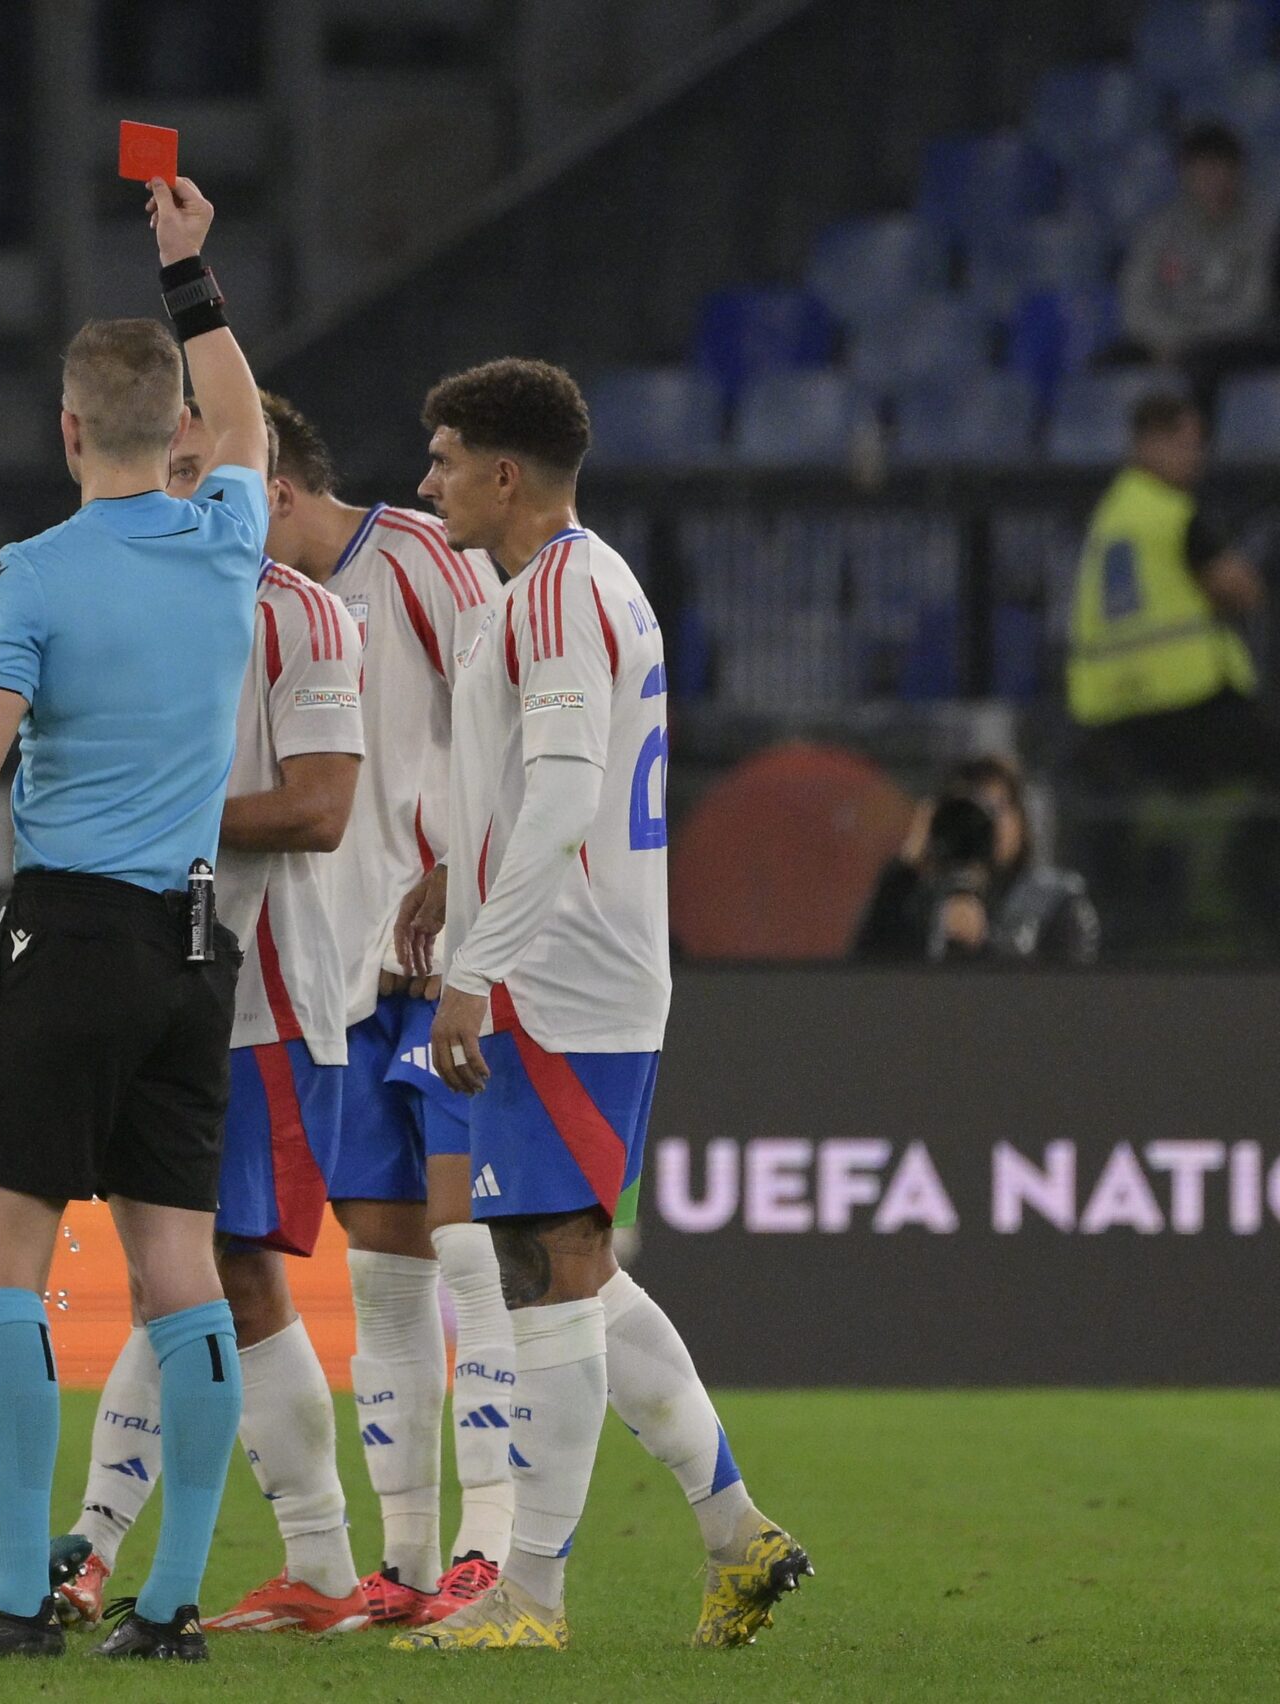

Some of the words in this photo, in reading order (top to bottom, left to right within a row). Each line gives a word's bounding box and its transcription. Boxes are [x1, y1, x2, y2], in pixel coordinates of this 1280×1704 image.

[295, 693, 357, 704] FOUNDATION
[524, 694, 584, 709] FOUNDATION
[655, 1137, 961, 1234] UEFA
[991, 1137, 1280, 1235] NATI
[455, 1362, 516, 1386] ITALIA
